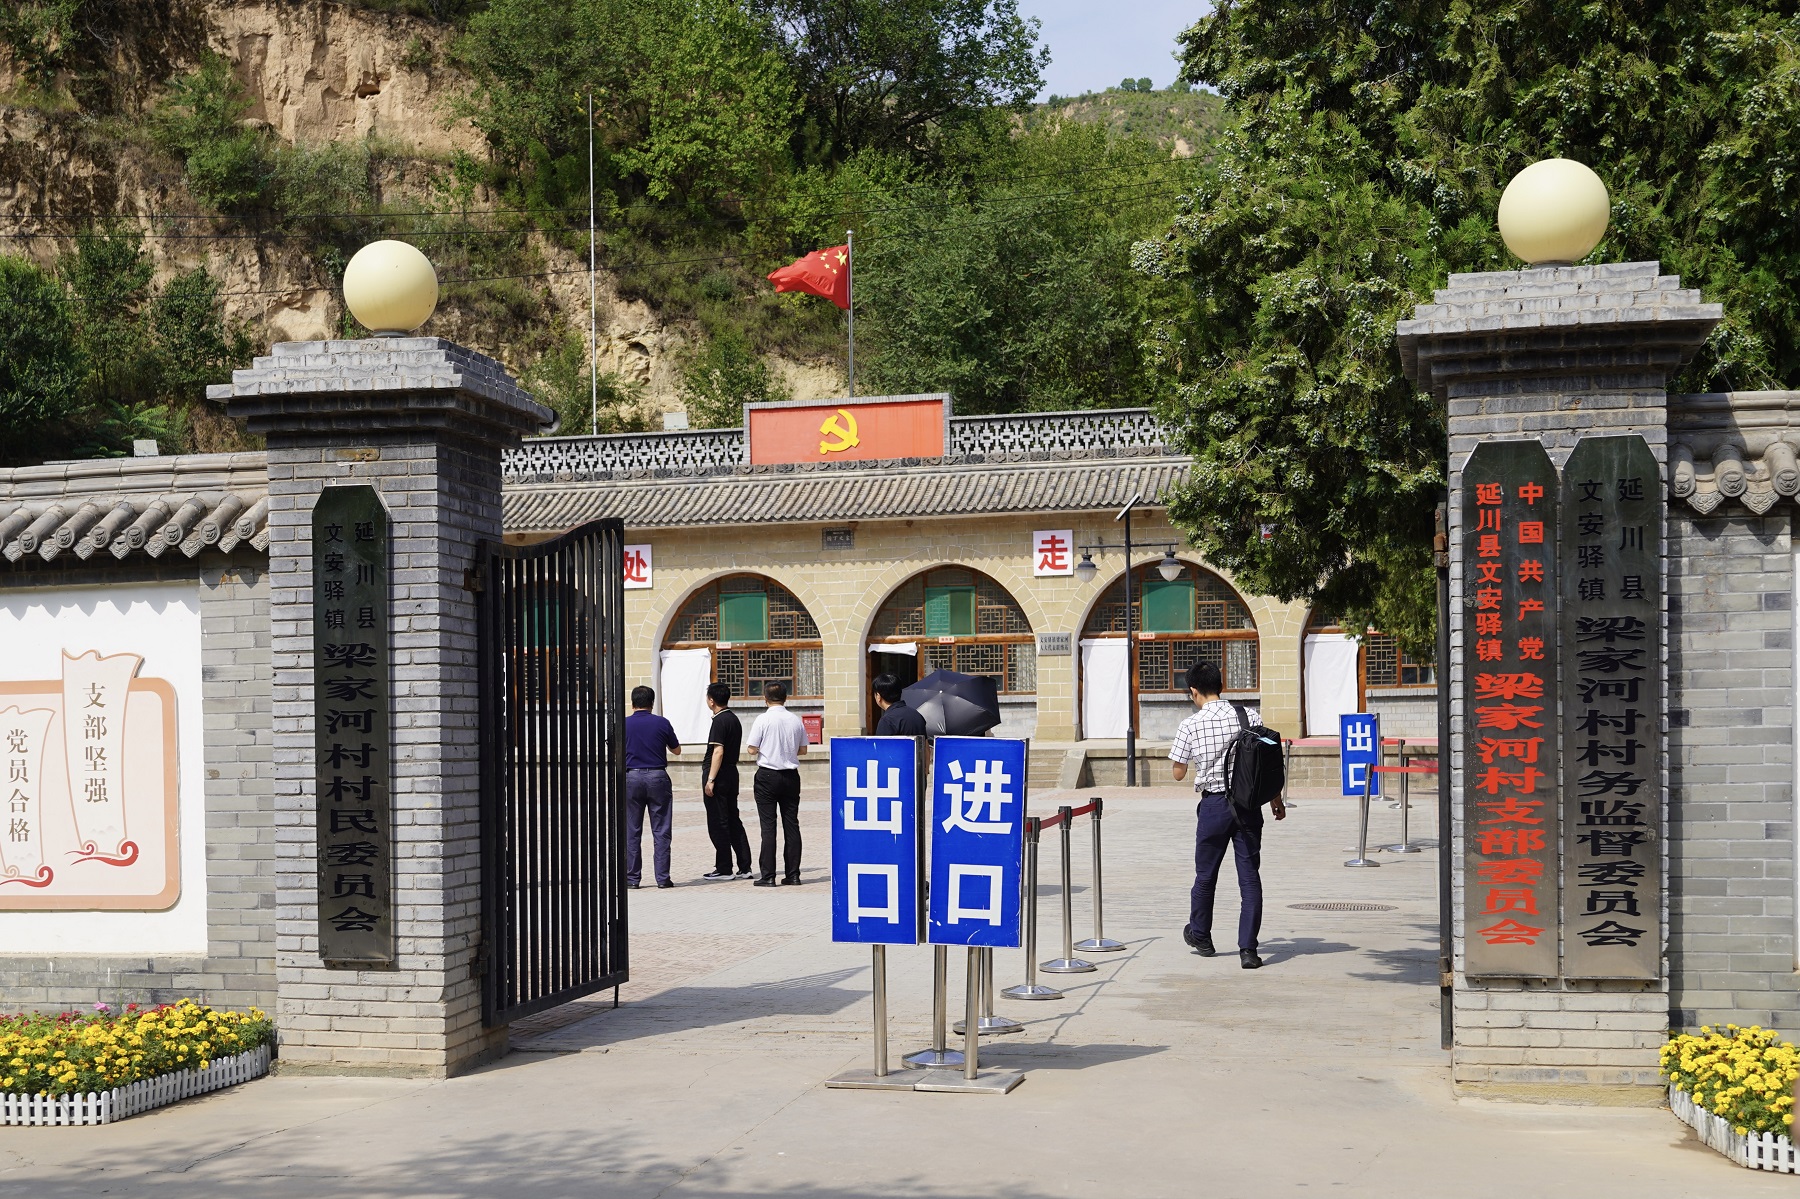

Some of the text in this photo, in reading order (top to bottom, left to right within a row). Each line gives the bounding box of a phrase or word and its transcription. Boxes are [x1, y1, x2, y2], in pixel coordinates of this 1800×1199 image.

[323, 522, 346, 630] 文安驿镇
[354, 521, 377, 629] 延川县
[624, 550, 648, 583] 处
[1038, 535, 1068, 570] 走
[1475, 482, 1503, 662] 延川县文安驿镇
[1518, 481, 1545, 661] 中国共产党
[1577, 479, 1606, 601] 文安驿镇
[1618, 477, 1645, 600] 延川县
[6, 728, 31, 843] 党员合格
[82, 683, 109, 803] 支部坚强
[322, 642, 382, 933] 梁家河村村民委员会
[1576, 616, 1648, 947] 梁家河村村务监督委员会
[844, 759, 903, 925] 出口
[941, 759, 1013, 927] 进口
[1474, 672, 1546, 946] 梁家河村支部委员会
